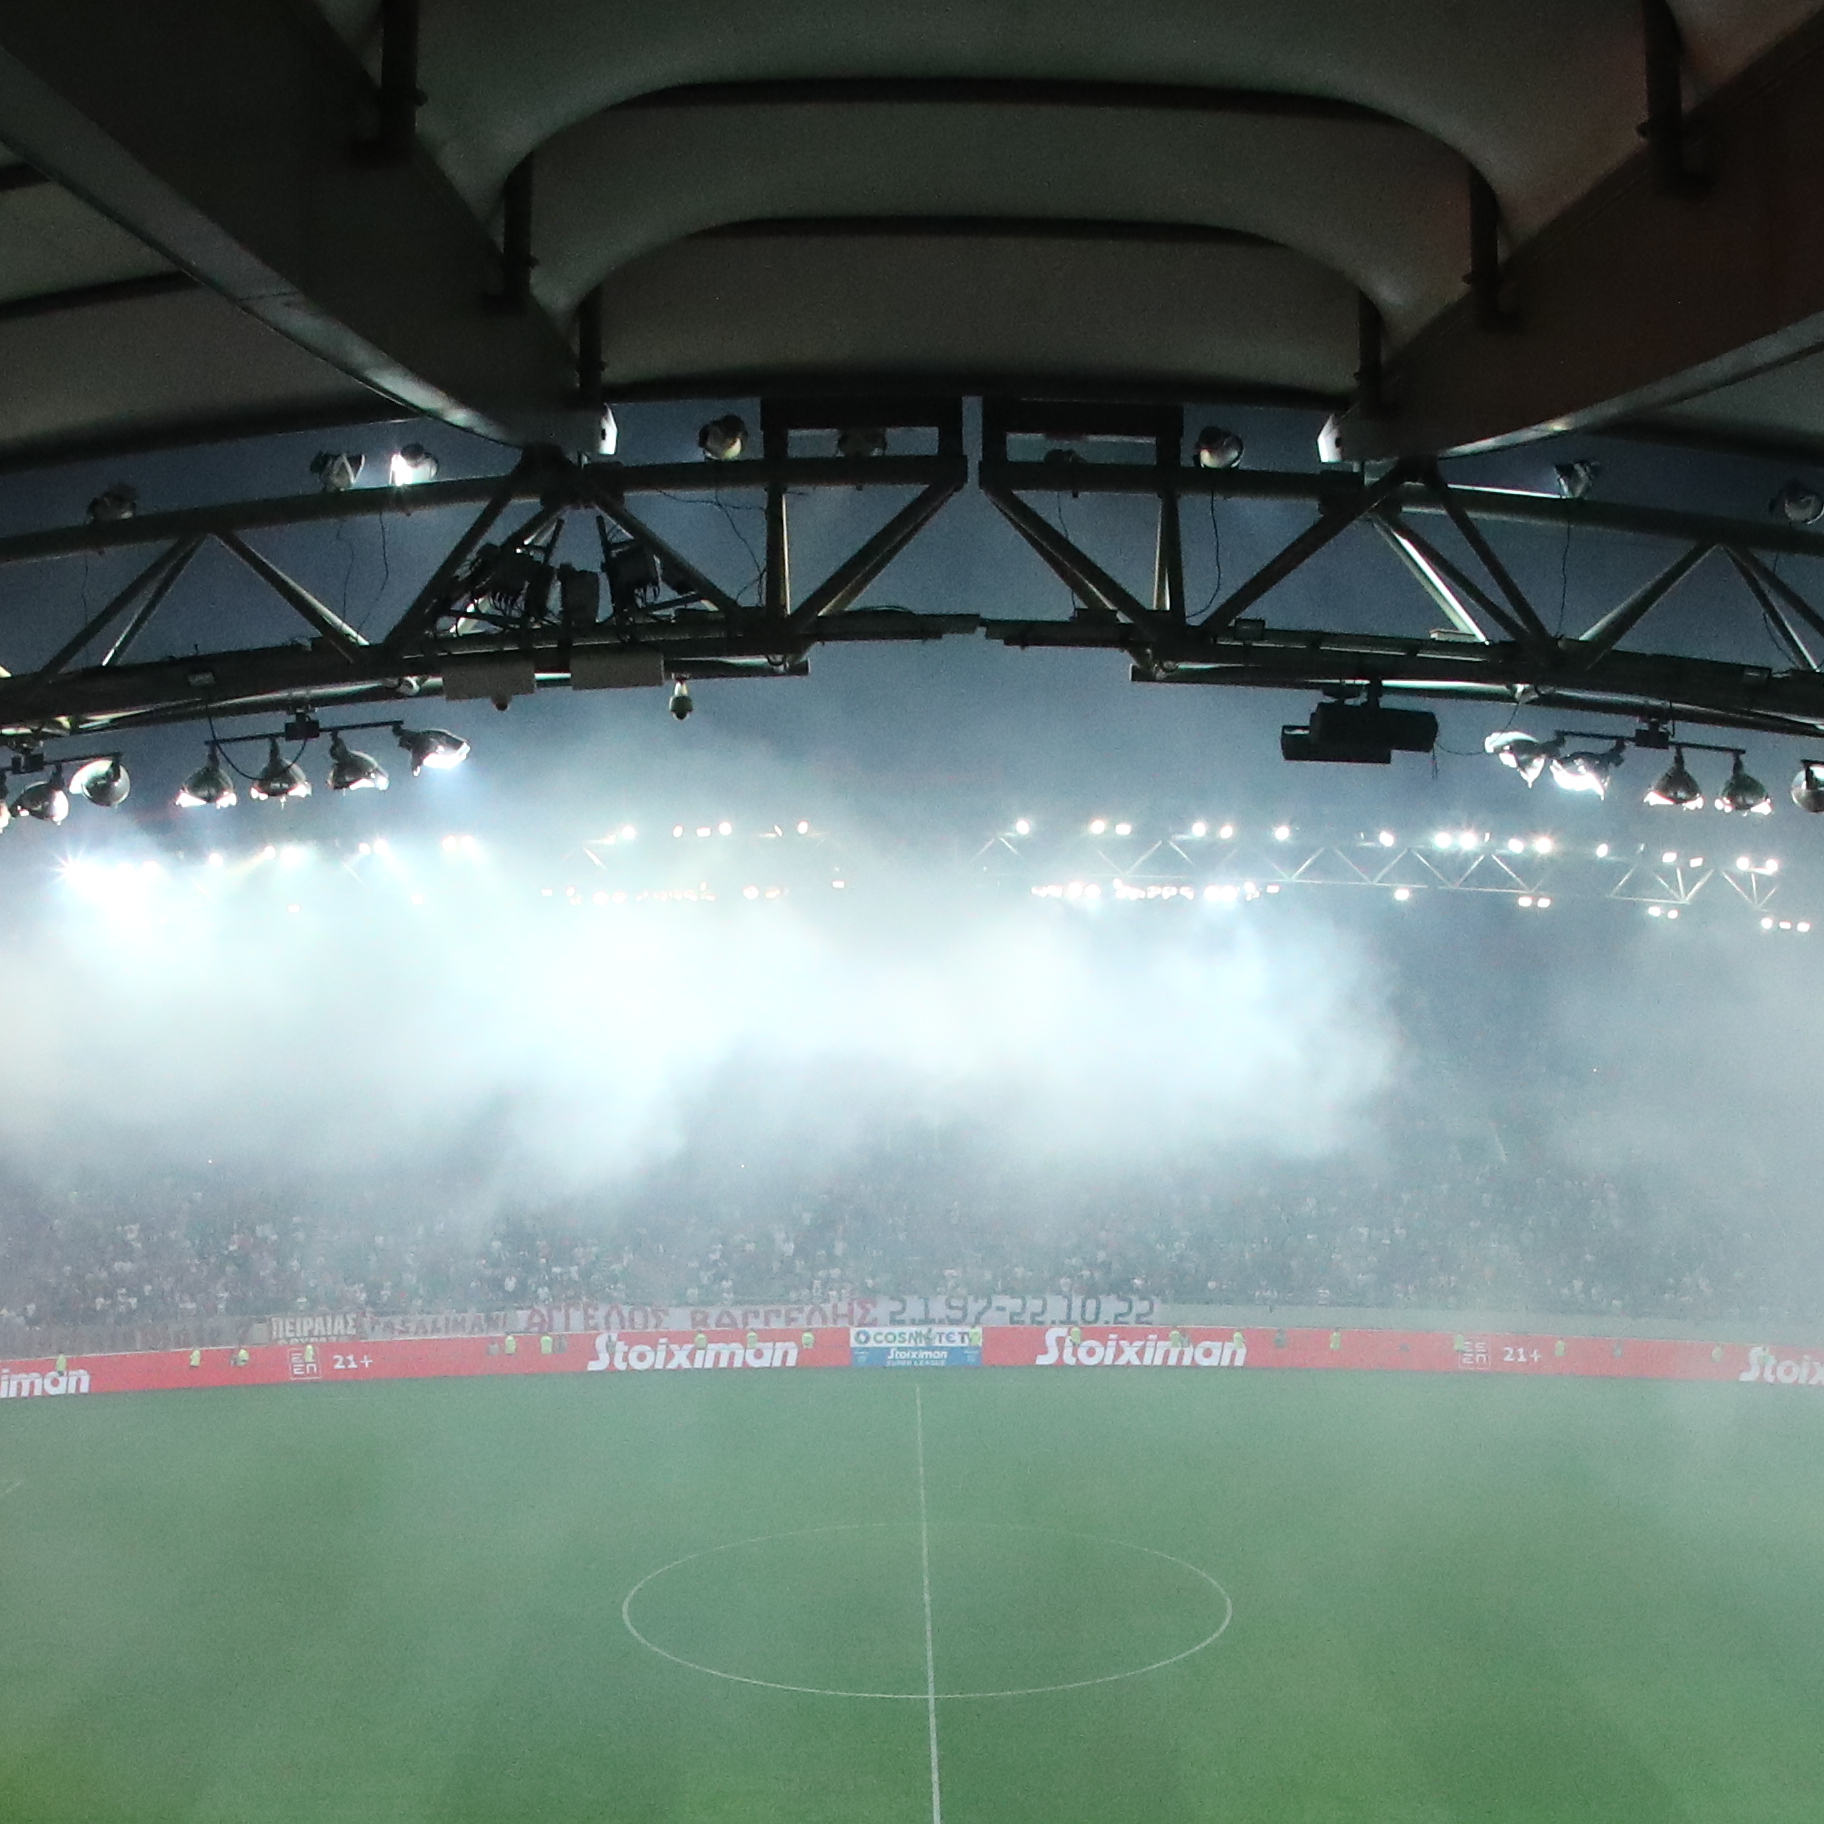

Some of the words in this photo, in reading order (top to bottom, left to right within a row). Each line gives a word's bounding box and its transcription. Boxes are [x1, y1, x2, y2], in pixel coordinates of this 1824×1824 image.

[272, 1315, 358, 1338] ΠΕΙΡΑΙΑΣ
[873, 1331, 957, 1345] COSMTE
[587, 1333, 798, 1371] Stoiximan
[887, 1349, 948, 1360] Stoiximan
[1036, 1328, 1247, 1366] Stoiximan
[1503, 1346, 1543, 1363] 21+
[333, 1355, 374, 1369] 21+
